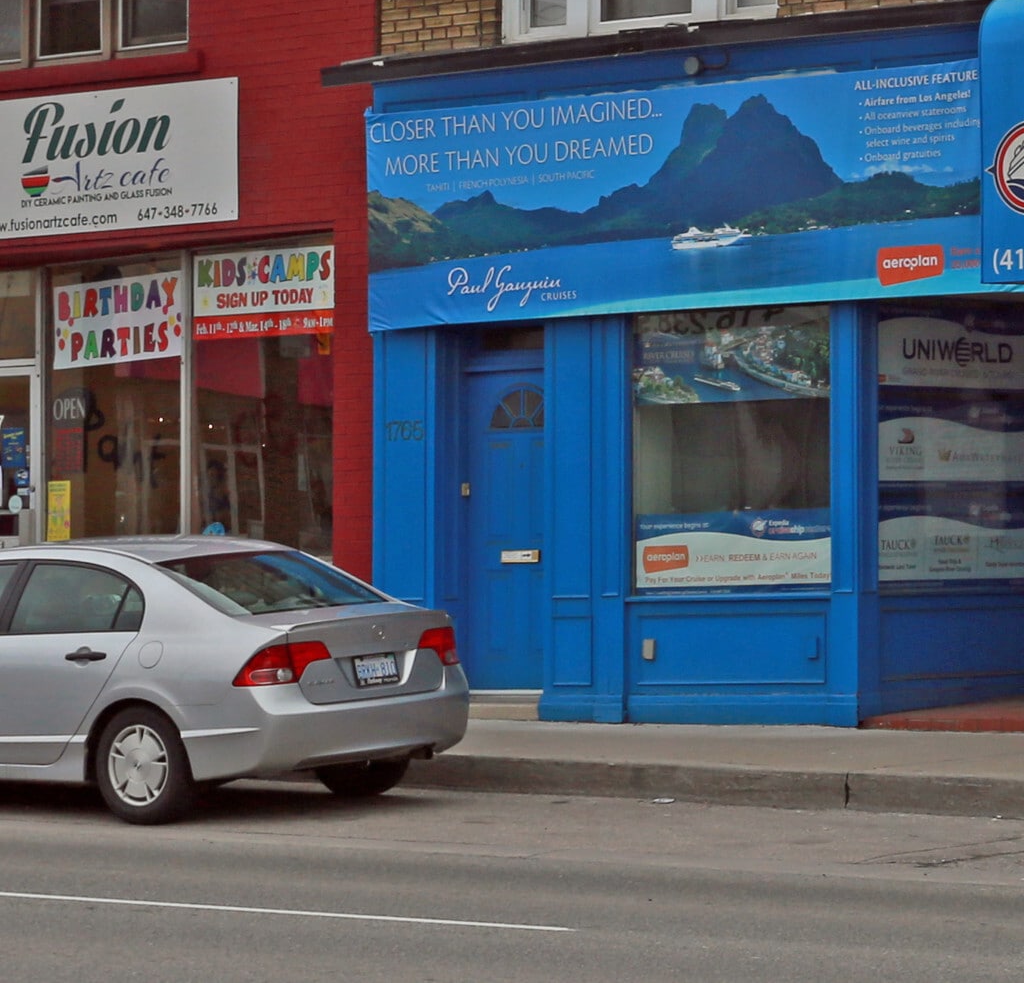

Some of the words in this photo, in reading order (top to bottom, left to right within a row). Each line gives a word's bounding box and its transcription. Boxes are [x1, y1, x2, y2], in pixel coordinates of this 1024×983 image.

[854, 75, 929, 90] ALL-INCLUSIVE
[864, 97, 894, 107] Airfare
[896, 94, 917, 104] from
[919, 94, 932, 102] Los
[934, 90, 971, 102] Angeles!
[370, 118, 436, 143] CLOSER
[441, 113, 495, 136] THAN
[501, 108, 546, 131] YOU
[550, 97, 662, 125] IMAGINED...
[864, 112, 875, 121] All
[877, 110, 919, 120] oceanview
[921, 105, 967, 117] staterooms
[22, 98, 171, 164] Fusion
[864, 124, 900, 135] Onboard
[902, 122, 942, 133] beverages
[944, 118, 980, 128] including
[866, 139, 889, 148] select
[891, 137, 910, 146] wine
[912, 135, 928, 144] and
[929, 133, 955, 145] spirits
[385, 156, 439, 177] MORE
[445, 149, 500, 171] THAN
[505, 143, 548, 166] YOU
[554, 134, 654, 162] DREAMED
[864, 151, 900, 162] Onboard
[902, 149, 941, 162] gratuities
[120, 158, 171, 187] cafe
[426, 183, 450, 192] TAHITI
[459, 180, 488, 190] FRENCH
[488, 176, 529, 188] POLYNESIA
[538, 173, 566, 183] SOUTH
[567, 170, 595, 180] PACIFIC
[21, 200, 33, 208] DIY
[34, 196, 66, 207] CERAMIC
[68, 194, 102, 204] PAINTING
[104, 192, 119, 201] AND
[120, 190, 144, 200] GLASS
[145, 188, 173, 198] FUSION
[137, 202, 218, 222] 647-348-7766
[198, 257, 247, 288] KIDS
[257, 250, 331, 284] CAMPS
[882, 255, 938, 271] aeroplan
[447, 267, 493, 296] Paul
[58, 276, 178, 321] BIRTHDAY
[216, 292, 247, 309] SIGN
[251, 290, 268, 306] UP
[272, 287, 314, 306] TODAY
[541, 290, 577, 302] CRUISES
[71, 321, 169, 362] PARTIES
[53, 398, 85, 420] OPEN
[881, 539, 911, 551] TAUCK
[934, 535, 963, 546] TAUCK
[647, 552, 685, 563] aeroplan
[728, 553, 761, 562] REDEEM
[769, 553, 790, 561] EARN
[792, 551, 817, 560] AGAIN
[645, 576, 656, 585] Pay
[670, 575, 685, 583] Your
[686, 575, 706, 583] Cruise
[715, 574, 741, 583] Upgrade
[743, 573, 756, 581] with
[791, 572, 808, 580] Miles
